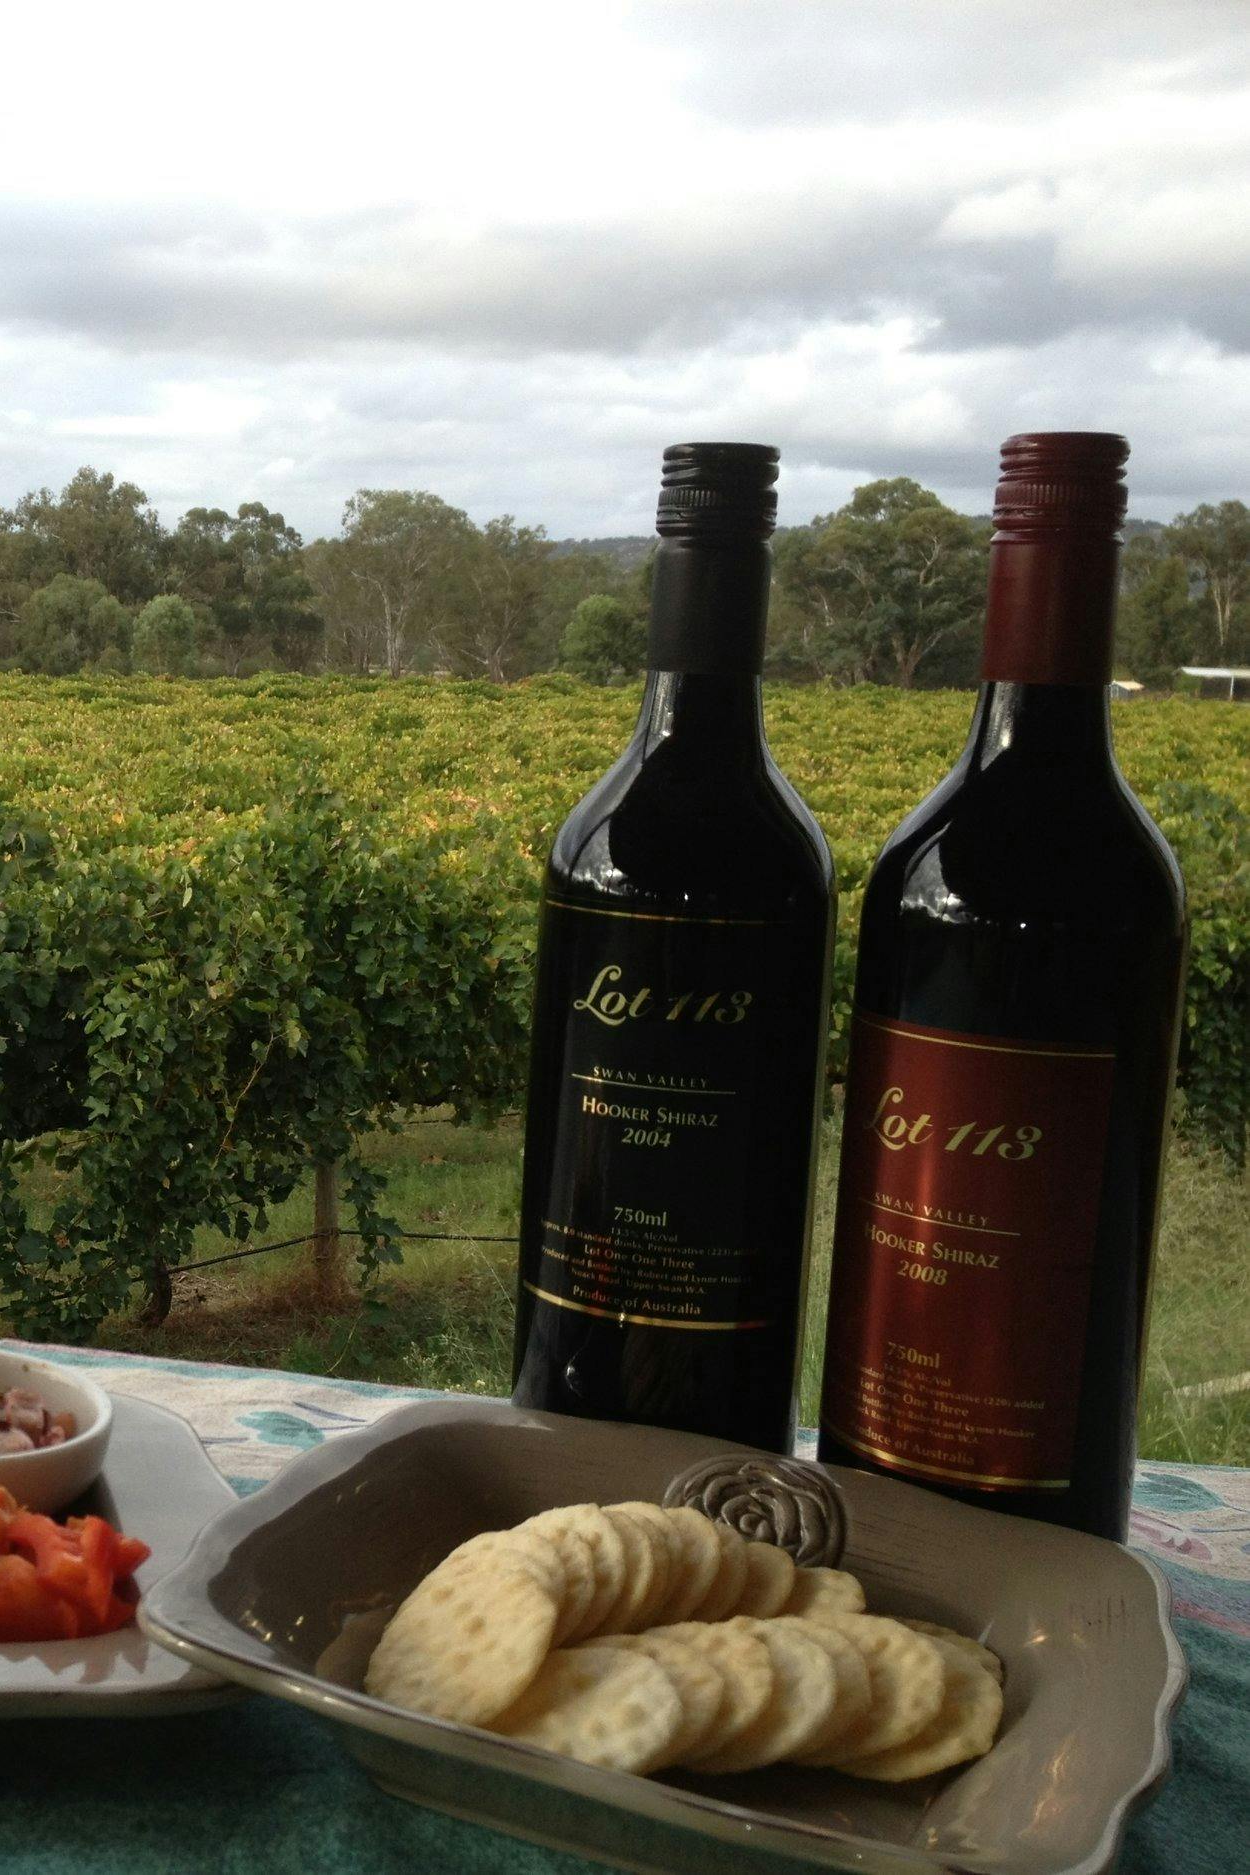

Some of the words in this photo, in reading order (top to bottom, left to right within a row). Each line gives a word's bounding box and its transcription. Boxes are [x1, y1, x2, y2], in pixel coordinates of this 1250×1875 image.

[573, 964, 654, 1027] Lot
[665, 991, 753, 1024] 113
[593, 1065, 637, 1081] SWAN
[647, 1074, 710, 1089] VALLEY
[582, 1094, 650, 1121] HOOKER
[657, 1106, 719, 1127] SHIRAZ
[863, 1085, 935, 1151] Lot
[944, 1120, 1044, 1160] 113
[621, 1127, 671, 1148] 2004
[613, 1206, 668, 1227] 750ml
[873, 1191, 915, 1212] SWAN
[923, 1203, 991, 1227] VALLEY
[583, 1243, 600, 1257] Lot
[603, 1247, 629, 1260] One
[631, 1253, 657, 1266] One
[661, 1257, 695, 1270] Three
[931, 1241, 1001, 1270] SHIRAZ
[671, 1273, 688, 1283] and
[897, 1259, 949, 1286] 2008
[572, 1284, 620, 1305] Produce
[624, 1297, 639, 1308] of
[641, 1298, 702, 1316] Australia
[888, 1340, 941, 1369] 750ml
[902, 1392, 929, 1409] One
[933, 1400, 970, 1418] Three
[1014, 1399, 1046, 1410] added
[998, 1428, 1036, 1441] Hooker
[894, 1438, 909, 1451] of
[912, 1443, 975, 1466] Australia
